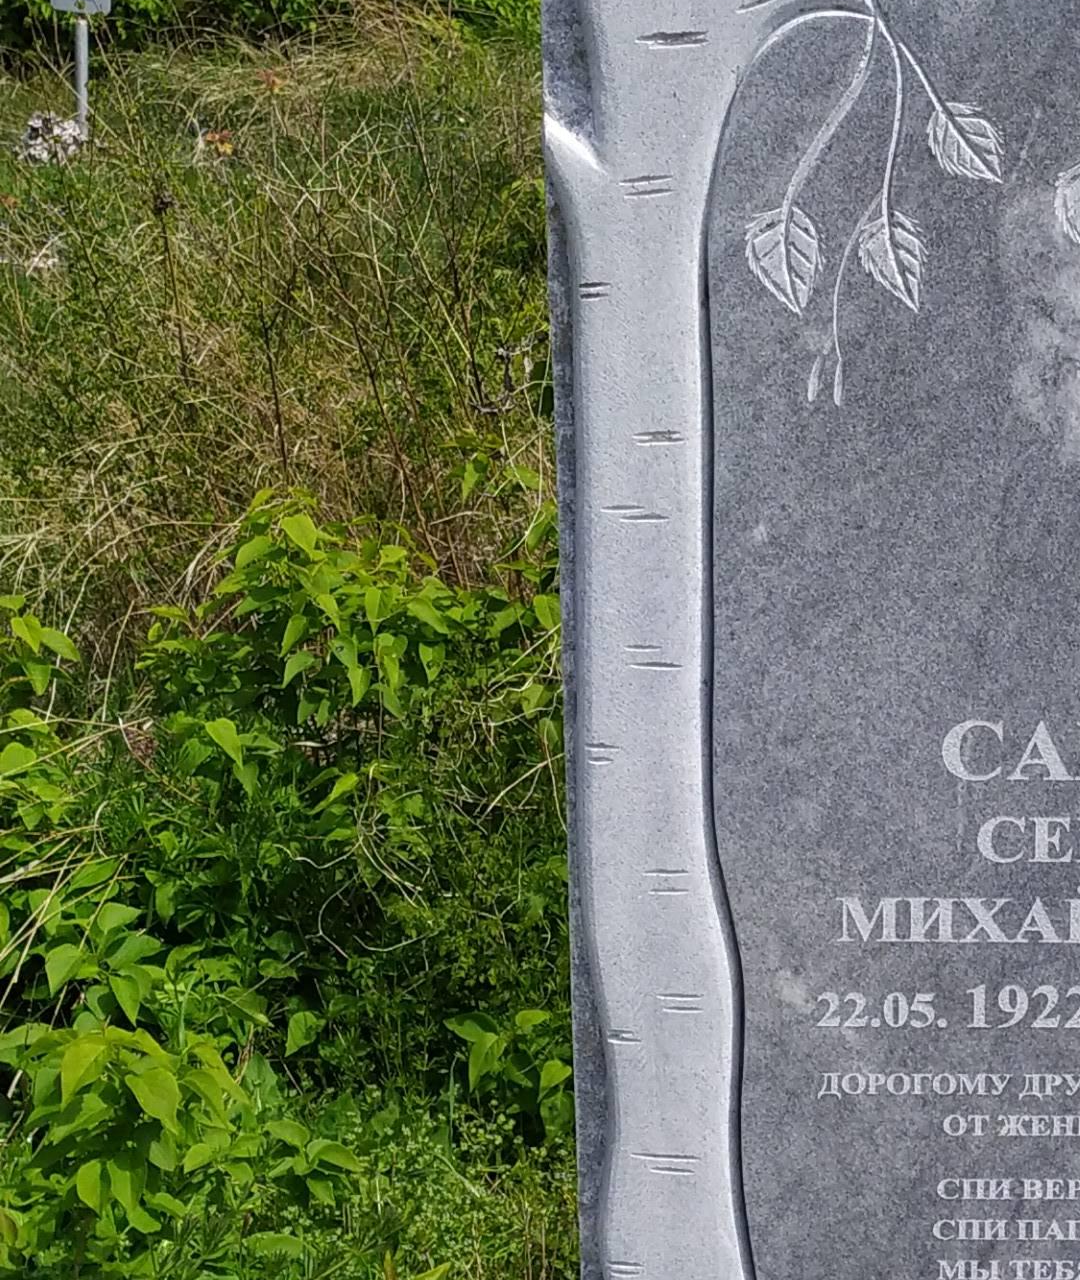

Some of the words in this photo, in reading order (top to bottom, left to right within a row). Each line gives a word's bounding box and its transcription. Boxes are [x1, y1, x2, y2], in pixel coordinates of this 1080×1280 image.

[816, 991, 948, 1029] 22.05.
[817, 1072, 1011, 1099] ДОРОГОМУ
[942, 1115, 992, 1137] ОТ
[936, 1178, 1012, 1201] СПИ
[932, 1218, 1008, 1242] СПИ
